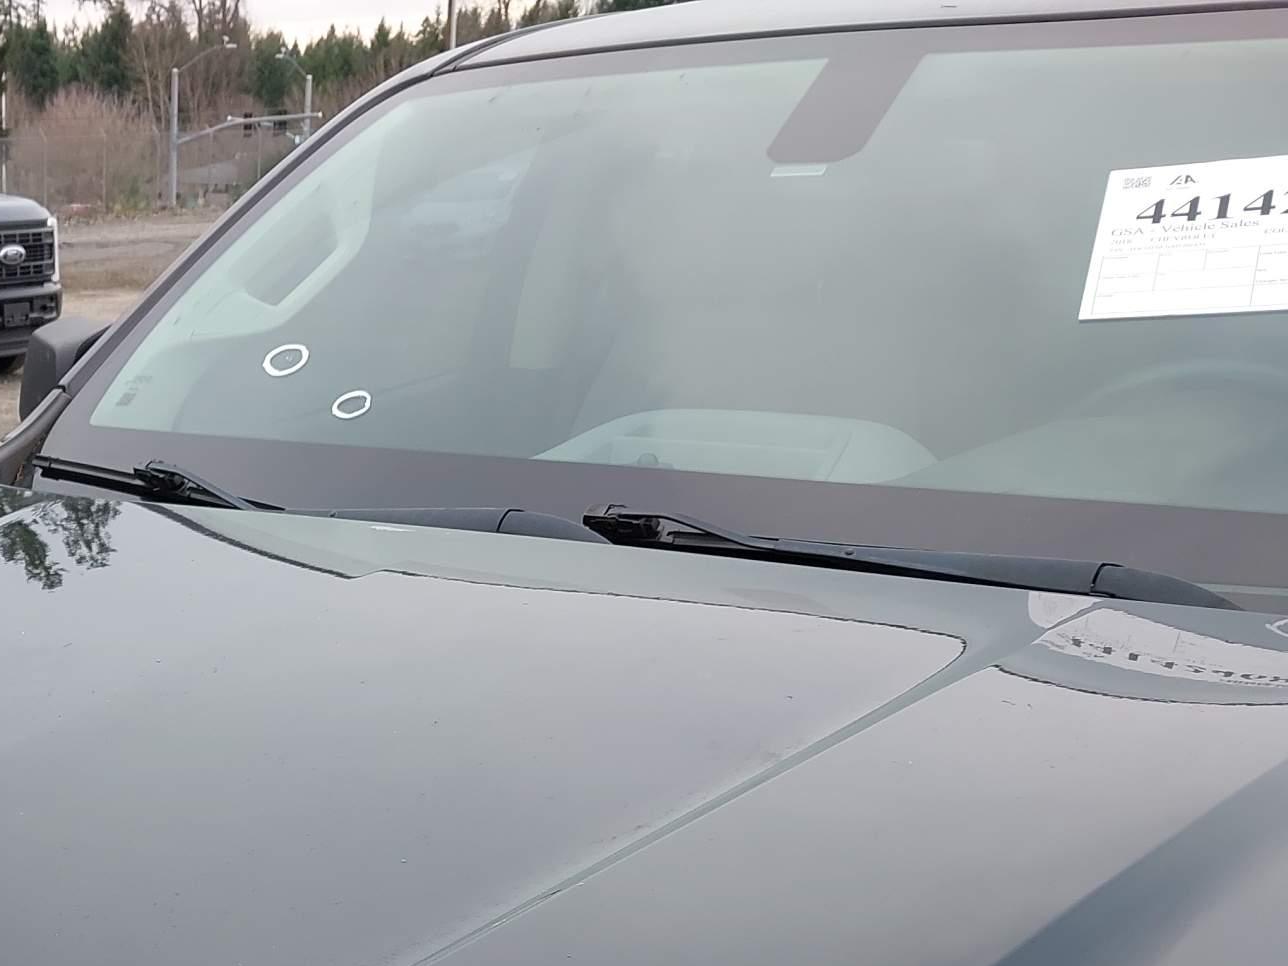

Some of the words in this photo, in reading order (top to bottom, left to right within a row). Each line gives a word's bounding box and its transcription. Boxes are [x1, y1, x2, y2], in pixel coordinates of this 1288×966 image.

[1111, 226, 1144, 237] GSA
[1161, 218, 1216, 234] Vehicle
[1220, 217, 1261, 229] Sales
